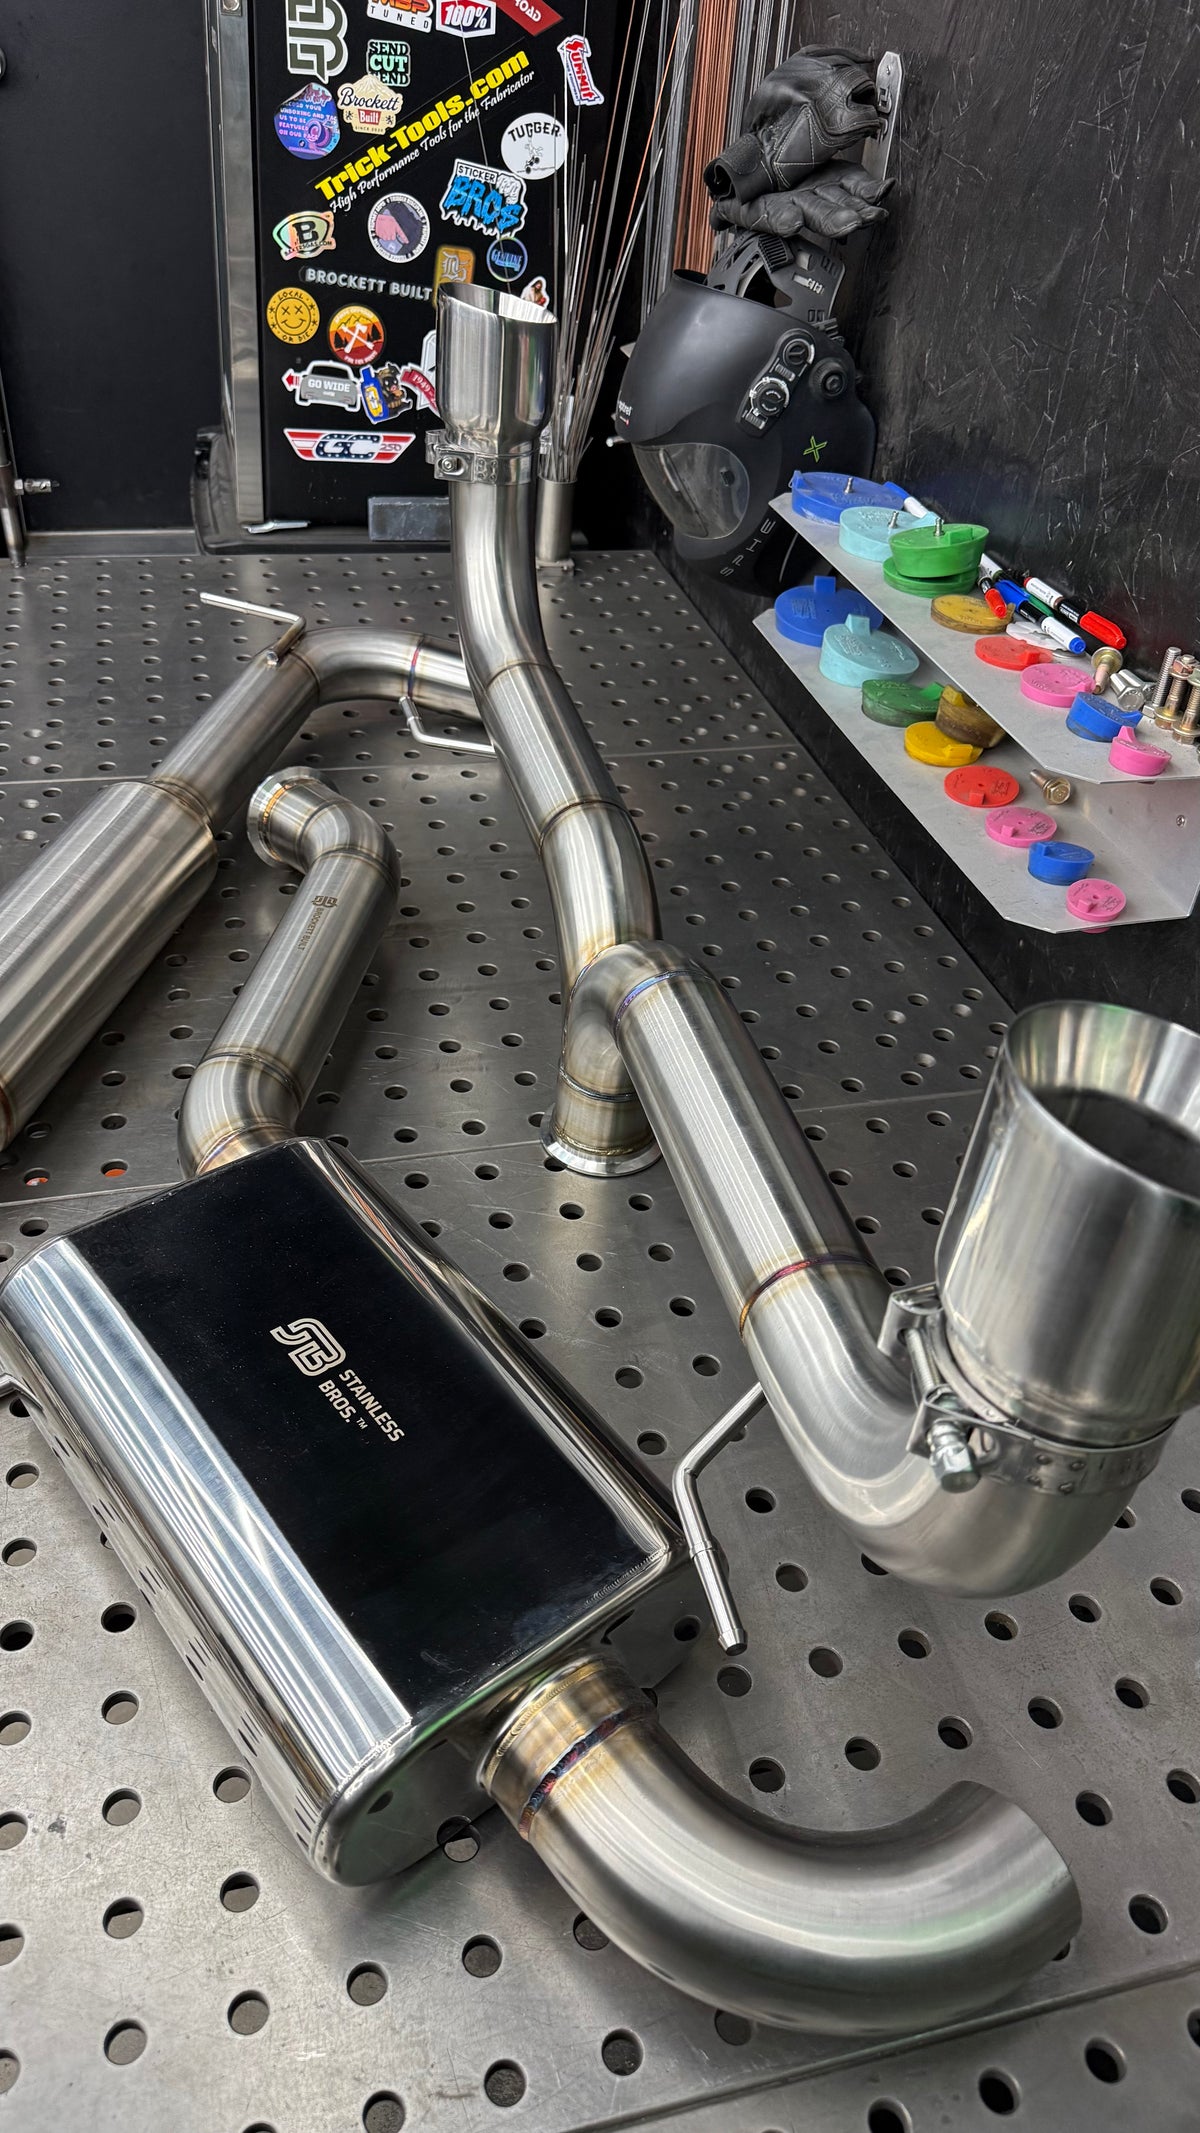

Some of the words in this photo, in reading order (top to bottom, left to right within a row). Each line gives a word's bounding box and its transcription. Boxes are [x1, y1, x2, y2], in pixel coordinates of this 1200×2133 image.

[370, 6, 429, 29] TUNED
[444, 4, 488, 29] 100%
[369, 41, 409, 56] SEND
[369, 54, 408, 72] CUT
[340, 87, 399, 111] Brockett
[315, 50, 530, 200] Trick-Tools.com
[360, 110, 379, 123] Built
[329, 187, 357, 213] High
[357, 149, 420, 194] Performance
[420, 129, 447, 151] Tools
[449, 120, 463, 137] for
[463, 107, 480, 123] the
[480, 71, 535, 111] Fabricator
[508, 121, 560, 142] TUGGER
[458, 165, 496, 183] STICKER
[444, 175, 522, 234] BROS
[292, 221, 319, 244] B
[277, 290, 304, 300] LOCAL
[305, 268, 387, 293] BROCKETT
[389, 282, 432, 301] BUILT
[281, 334, 293, 343] OR
[298, 331, 311, 342] DIE
[308, 378, 322, 389] GO
[323, 379, 351, 393] WIDE
[379, 443, 402, 452] 250
[318, 1379, 357, 1423] BROS.
[338, 1368, 406, 1442] STAINLESS
